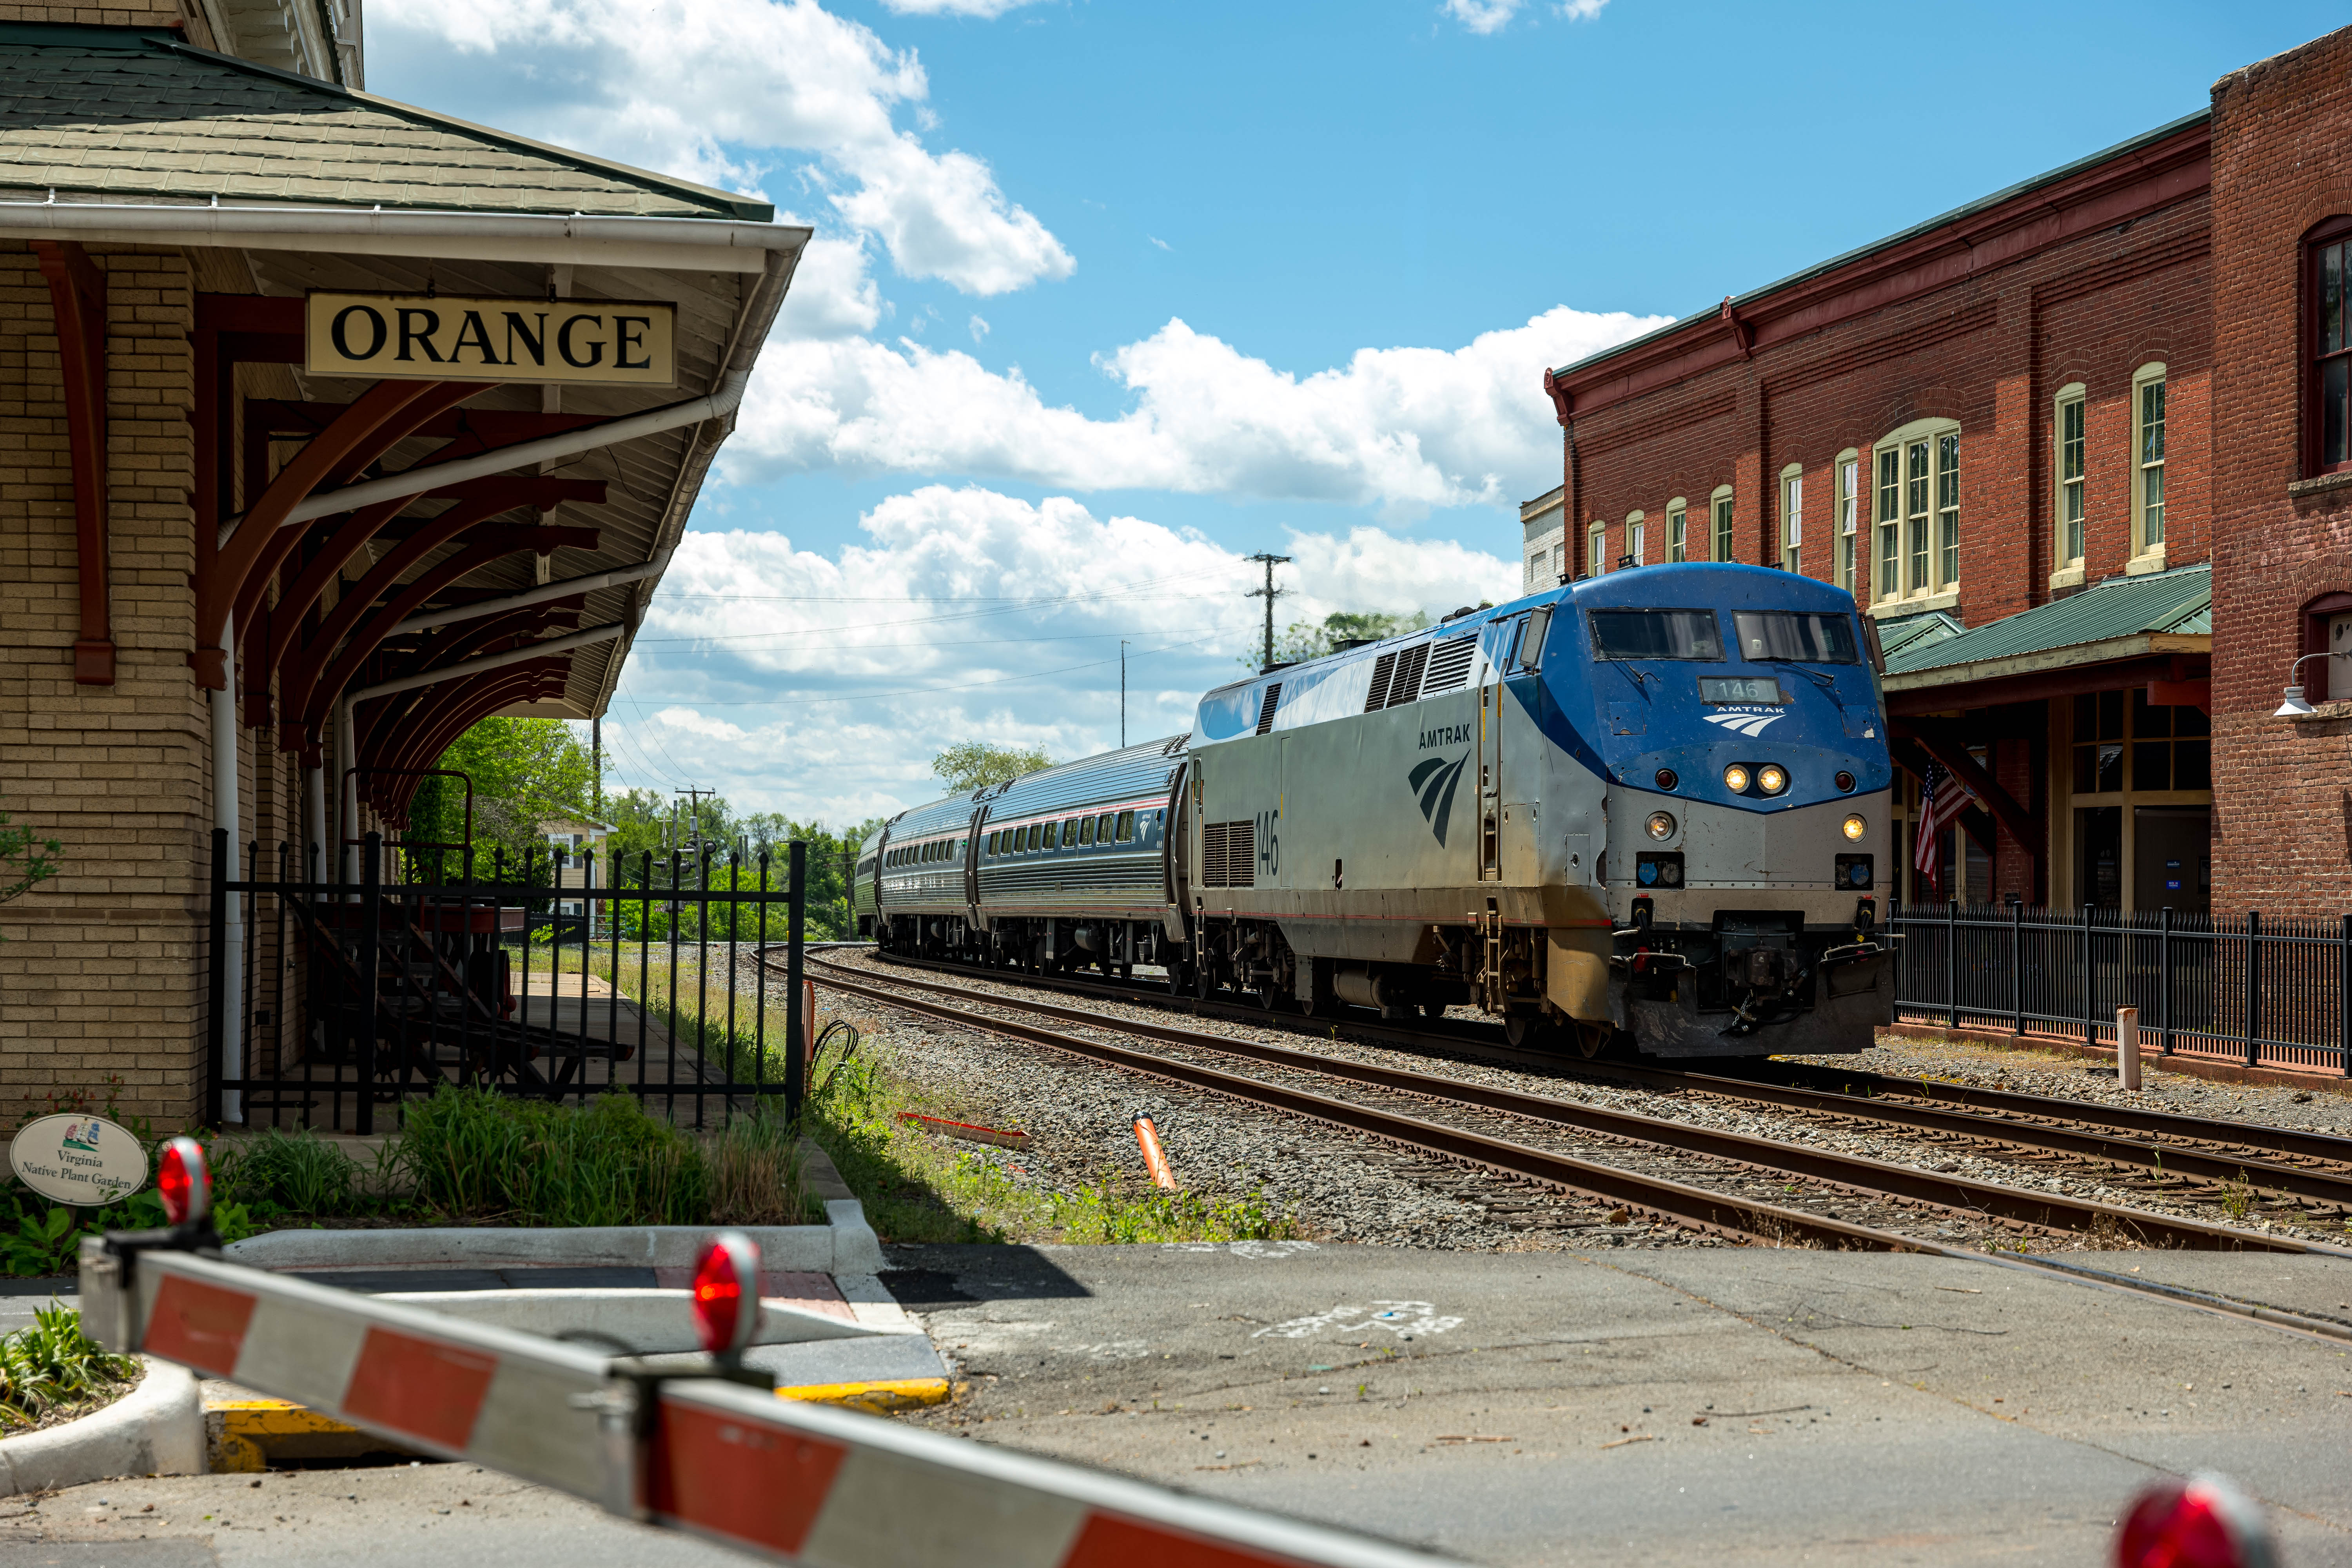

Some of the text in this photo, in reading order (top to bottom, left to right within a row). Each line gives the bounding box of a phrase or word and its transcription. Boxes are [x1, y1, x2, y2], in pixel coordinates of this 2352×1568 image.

[331, 305, 651, 369] ORANGE
[1719, 682, 1759, 698] 146
[1419, 723, 1471, 750] AMTRAK
[1256, 809, 1279, 877] 146
[57, 1150, 103, 1168] Virginia
[22, 1161, 131, 1189] Native Plant Garden
